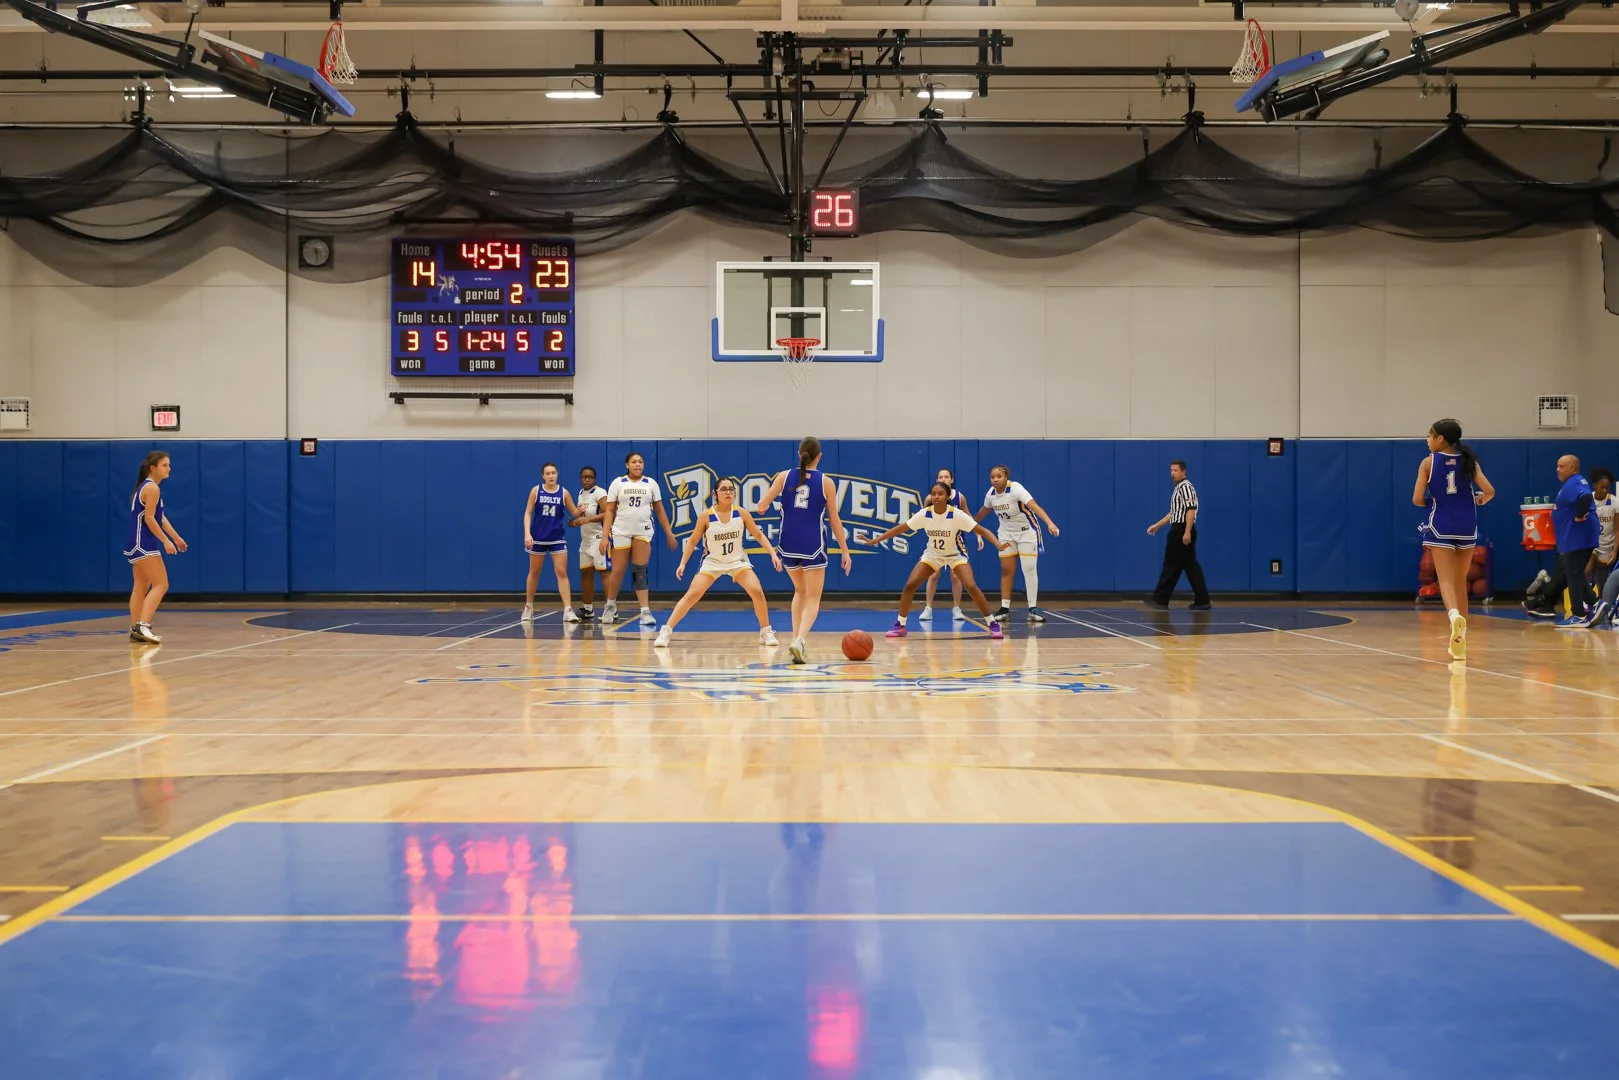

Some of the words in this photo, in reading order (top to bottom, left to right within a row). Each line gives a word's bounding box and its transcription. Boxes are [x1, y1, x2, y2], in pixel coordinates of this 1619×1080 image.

[815, 195, 853, 227] 26
[401, 243, 430, 256] Home
[462, 243, 521, 270] 4:54
[531, 244, 568, 257] Guests
[413, 261, 435, 287] 14
[536, 260, 569, 288] 23
[465, 289, 500, 303] period
[510, 283, 523, 304] 2
[397, 311, 423, 324] fouls
[464, 310, 499, 325] player
[542, 311, 567, 324] fouls
[407, 330, 419, 351] 3
[435, 330, 448, 351] 5
[467, 330, 505, 351] 1-24
[516, 331, 529, 351] 5
[550, 330, 563, 351] 2
[400, 359, 421, 369] won
[469, 359, 496, 372] game
[544, 359, 565, 369] won
[157, 412, 174, 425] EXIT
[1446, 470, 1458, 495] 1
[628, 496, 642, 508] 35
[793, 484, 811, 510] 2
[541, 504, 557, 517] 24
[1523, 515, 1535, 530] G
[713, 530, 740, 541] ROOSEVELT
[926, 529, 952, 538] ROOSEVELT
[721, 541, 734, 556] 10
[932, 538, 946, 550] 12
